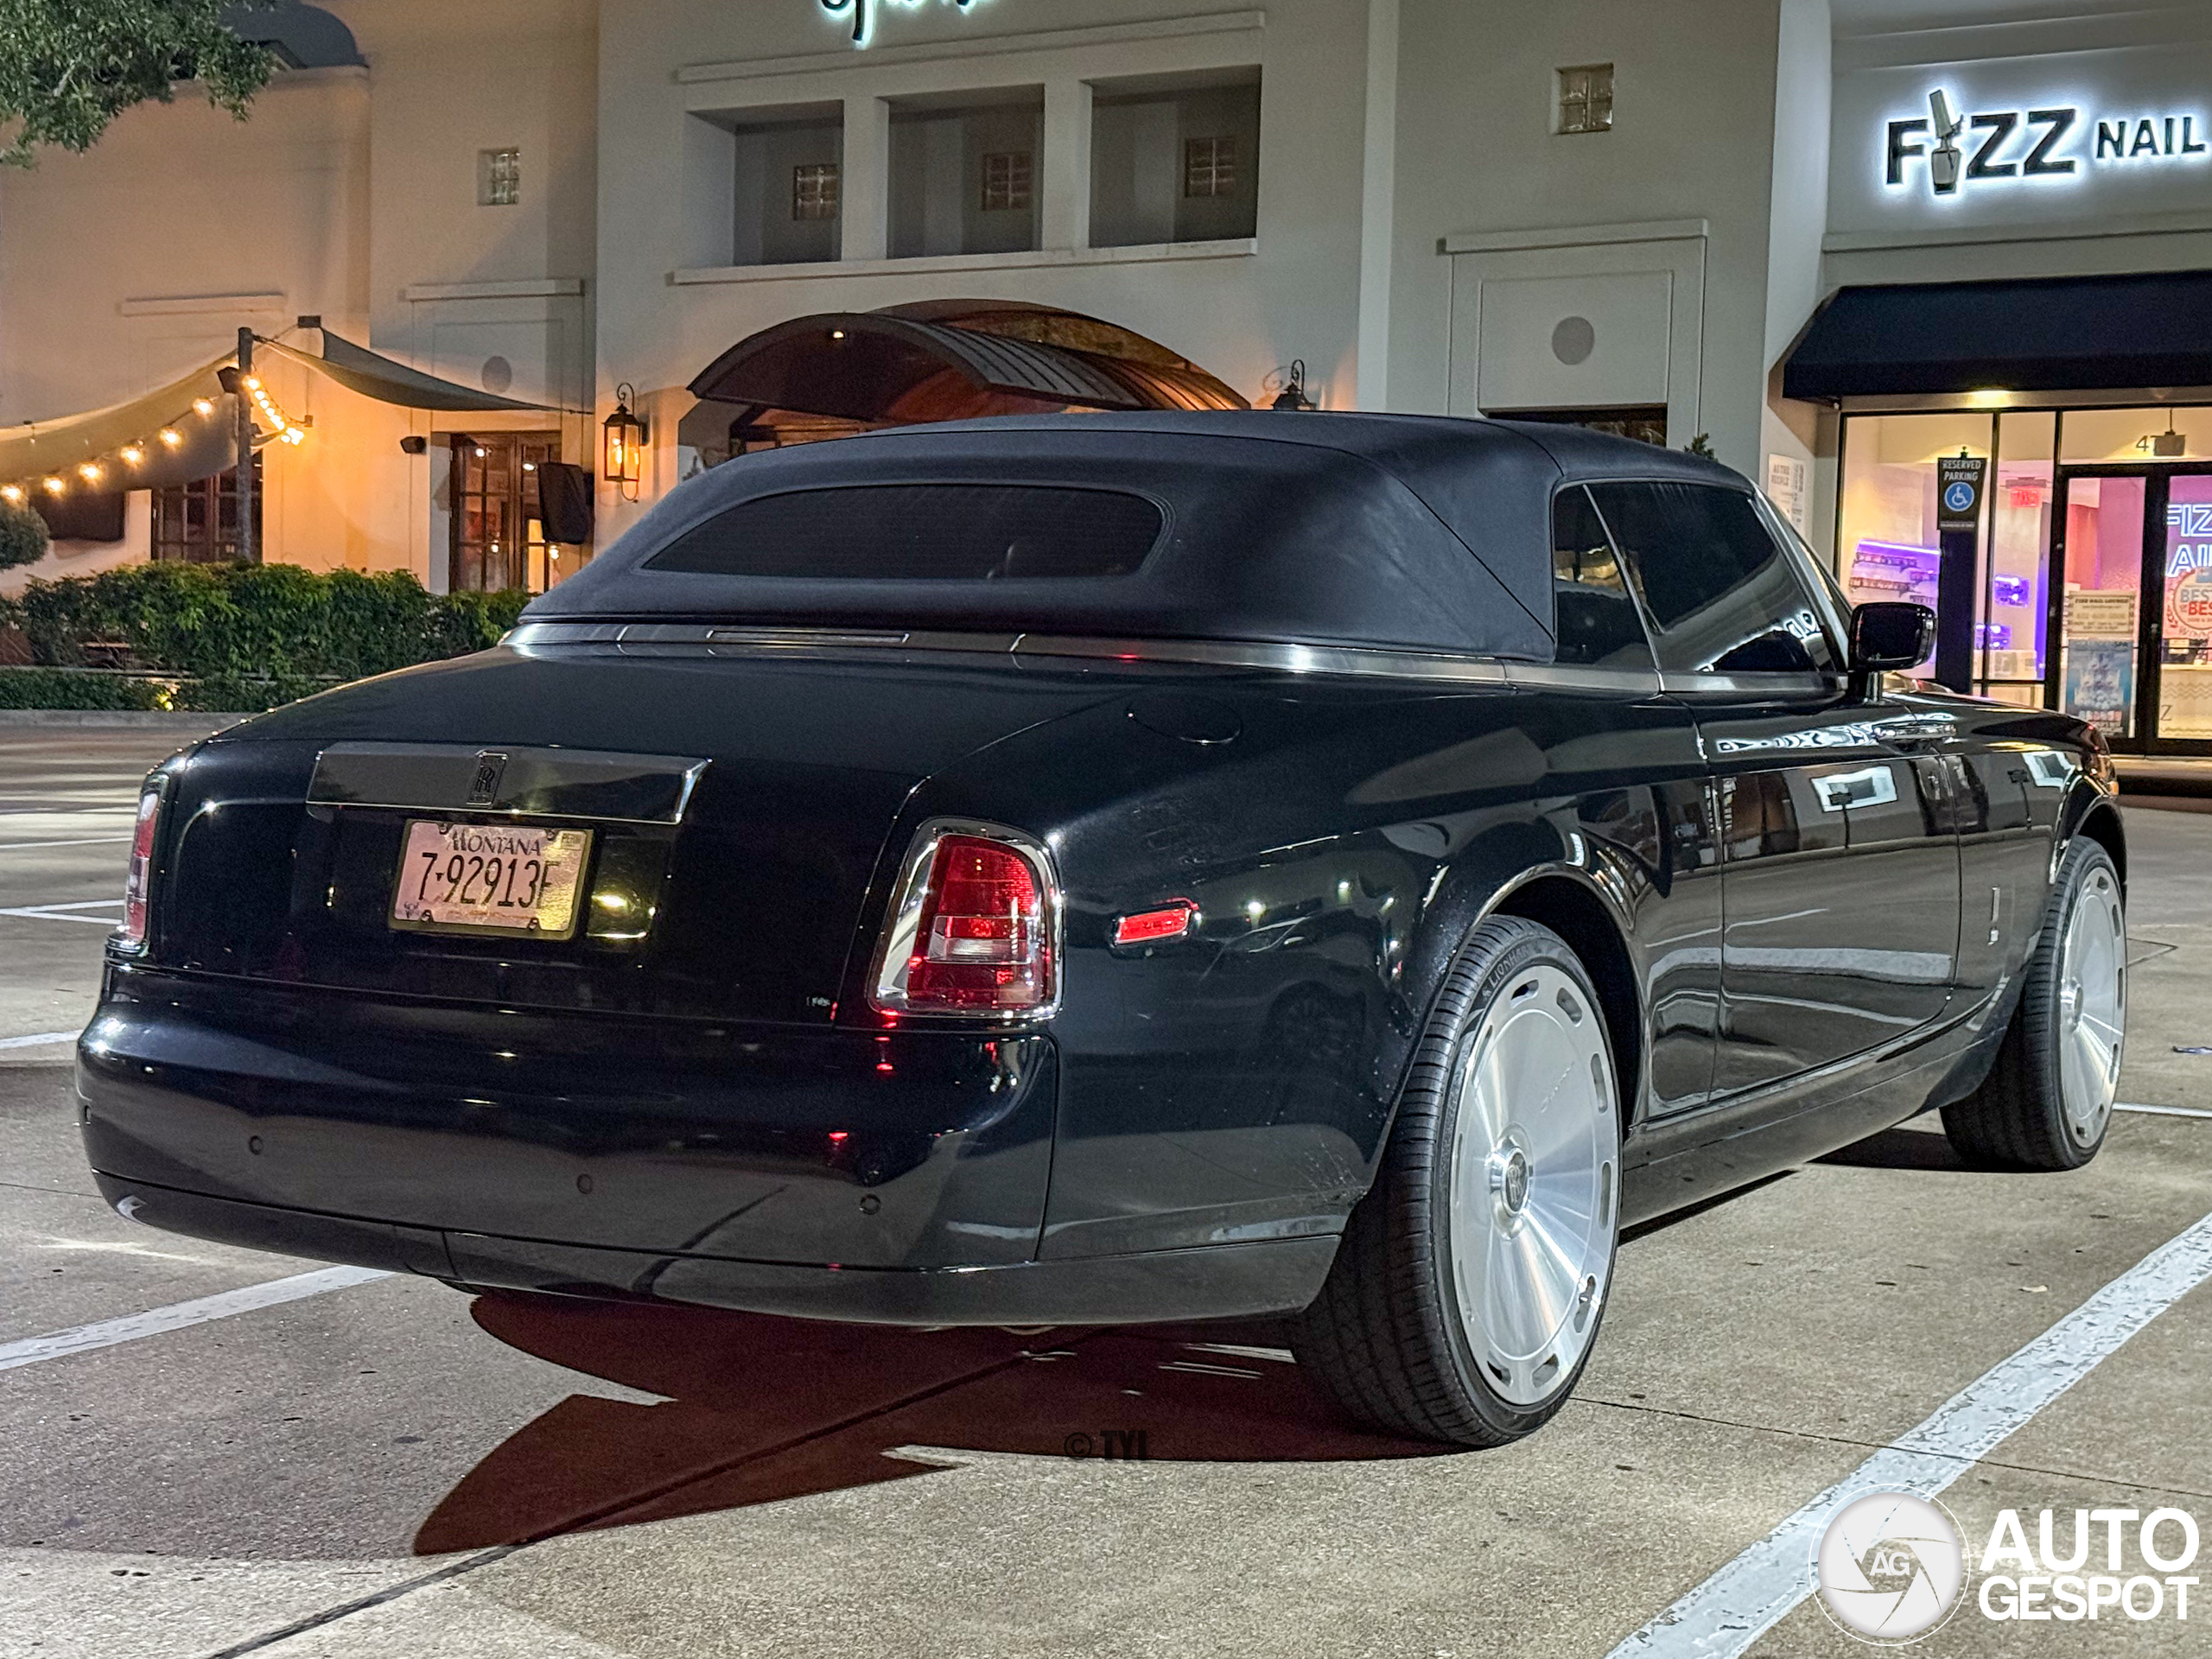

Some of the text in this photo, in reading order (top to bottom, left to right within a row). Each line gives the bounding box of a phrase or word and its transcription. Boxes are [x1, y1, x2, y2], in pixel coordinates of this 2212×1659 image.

[2096, 117, 2206, 159] NAIL
[1942, 460, 1981, 470] RESERVED
[1943, 471, 1979, 480] PARKING
[447, 830, 542, 856] MONTANA
